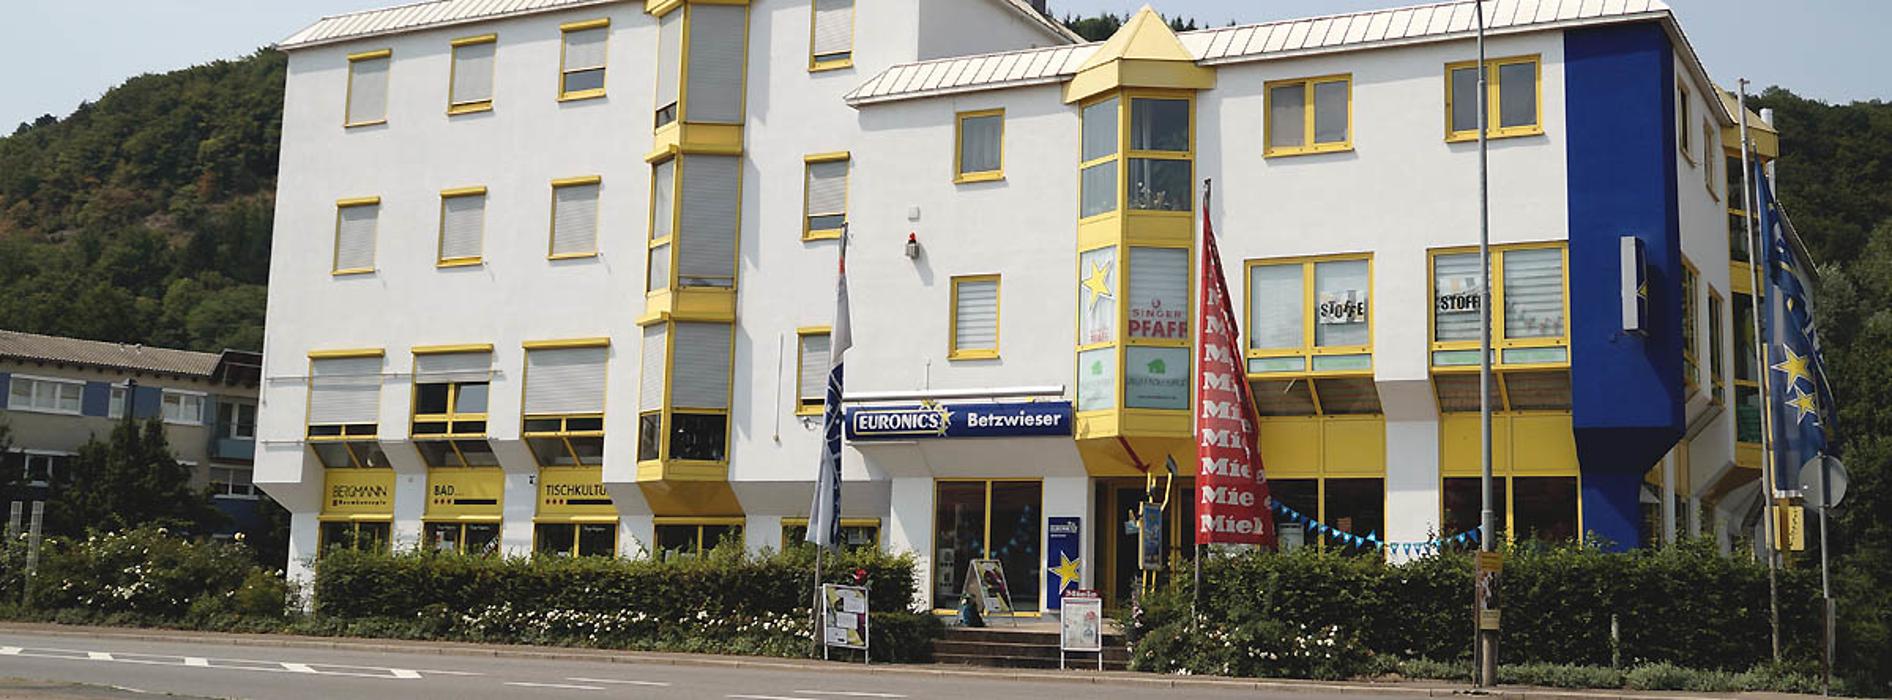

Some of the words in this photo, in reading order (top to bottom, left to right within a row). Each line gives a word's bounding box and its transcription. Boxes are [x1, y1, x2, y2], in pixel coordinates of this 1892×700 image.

[1132, 309, 1182, 318] SINGER
[1320, 300, 1364, 318] STOFFE
[1128, 319, 1188, 338] PFAFF
[858, 414, 939, 430] EURONICS
[967, 411, 1062, 428] Betzwieser
[332, 485, 387, 497] BERGMANN
[546, 484, 607, 496] TISCHKULTU
[1200, 514, 1264, 535] Miel
